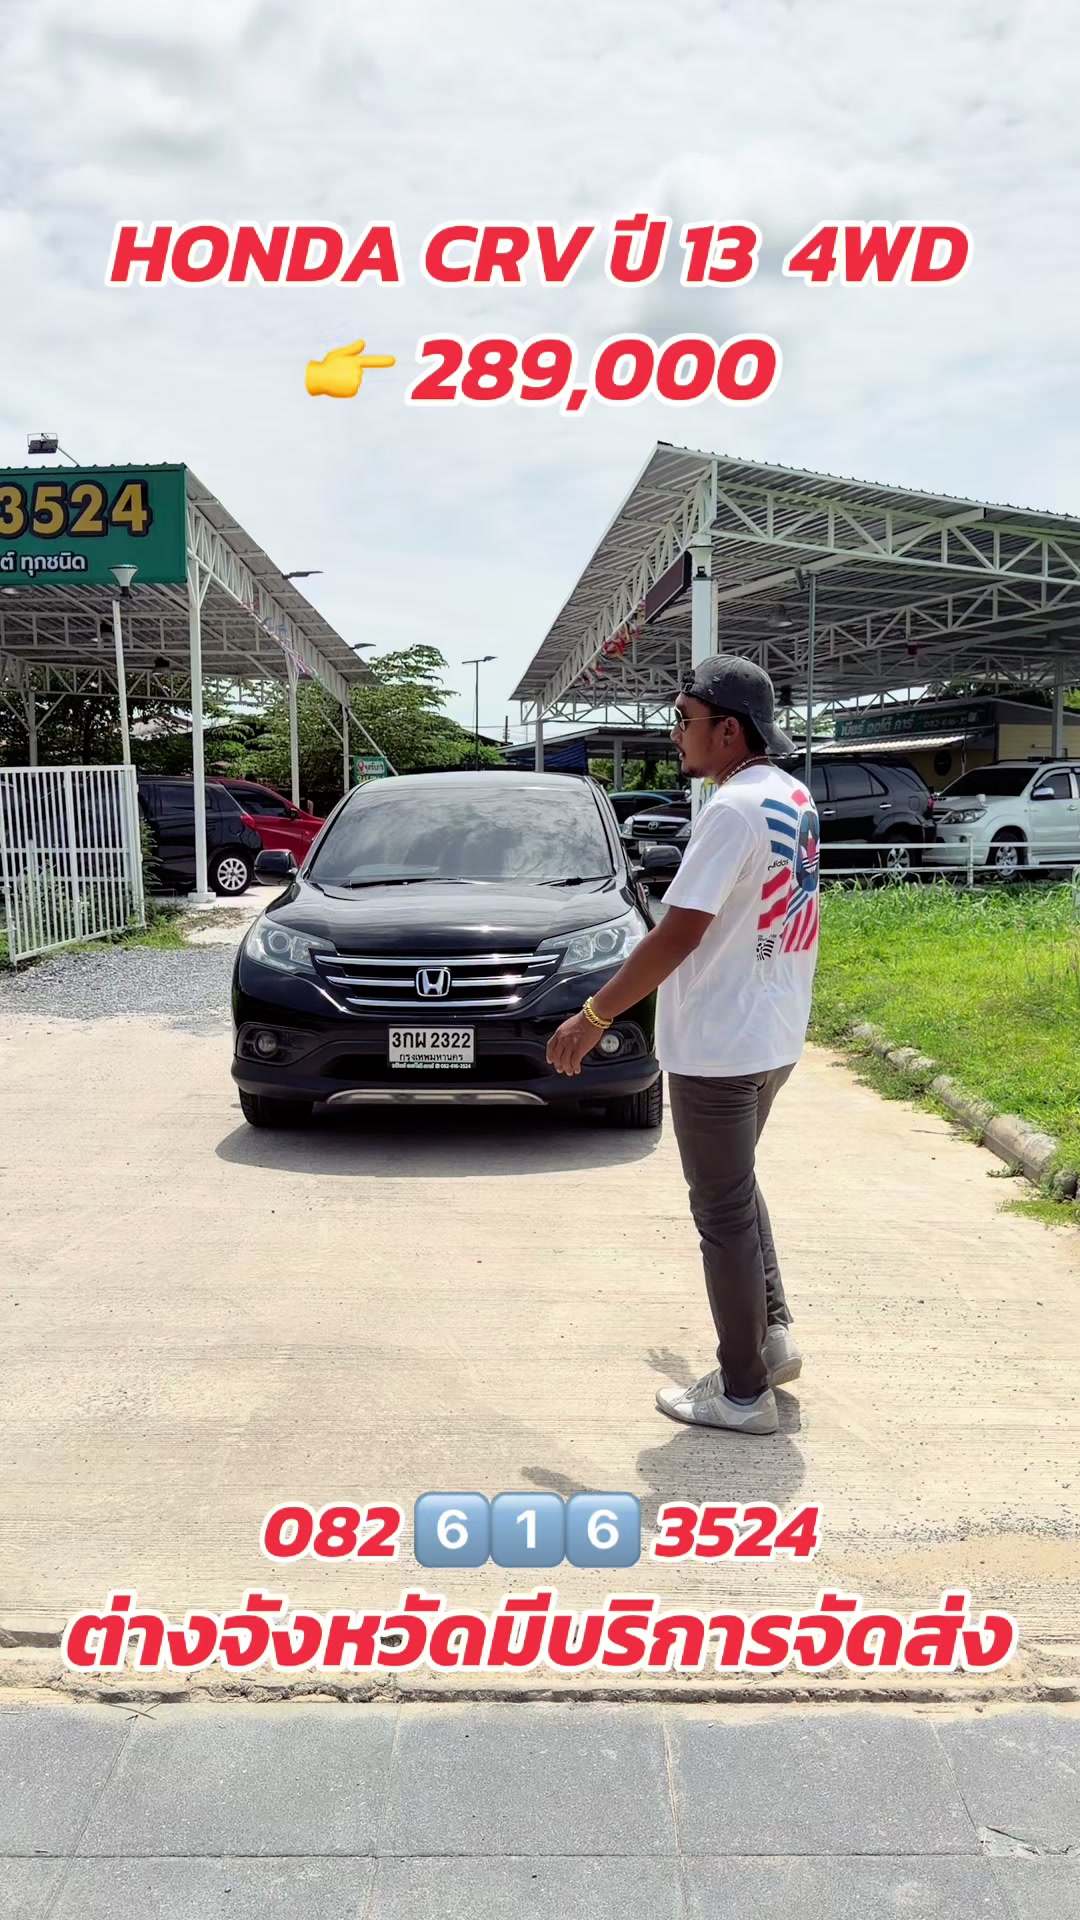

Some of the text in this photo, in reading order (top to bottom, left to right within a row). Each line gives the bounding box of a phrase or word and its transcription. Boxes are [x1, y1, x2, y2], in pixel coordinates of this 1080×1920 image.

[0, 483, 149, 536] 3524
[20, 551, 87, 577] ทุกชนิด
[430, 1032, 471, 1049] 2322
[399, 1053, 464, 1062] กรุงเทพมหานคร
